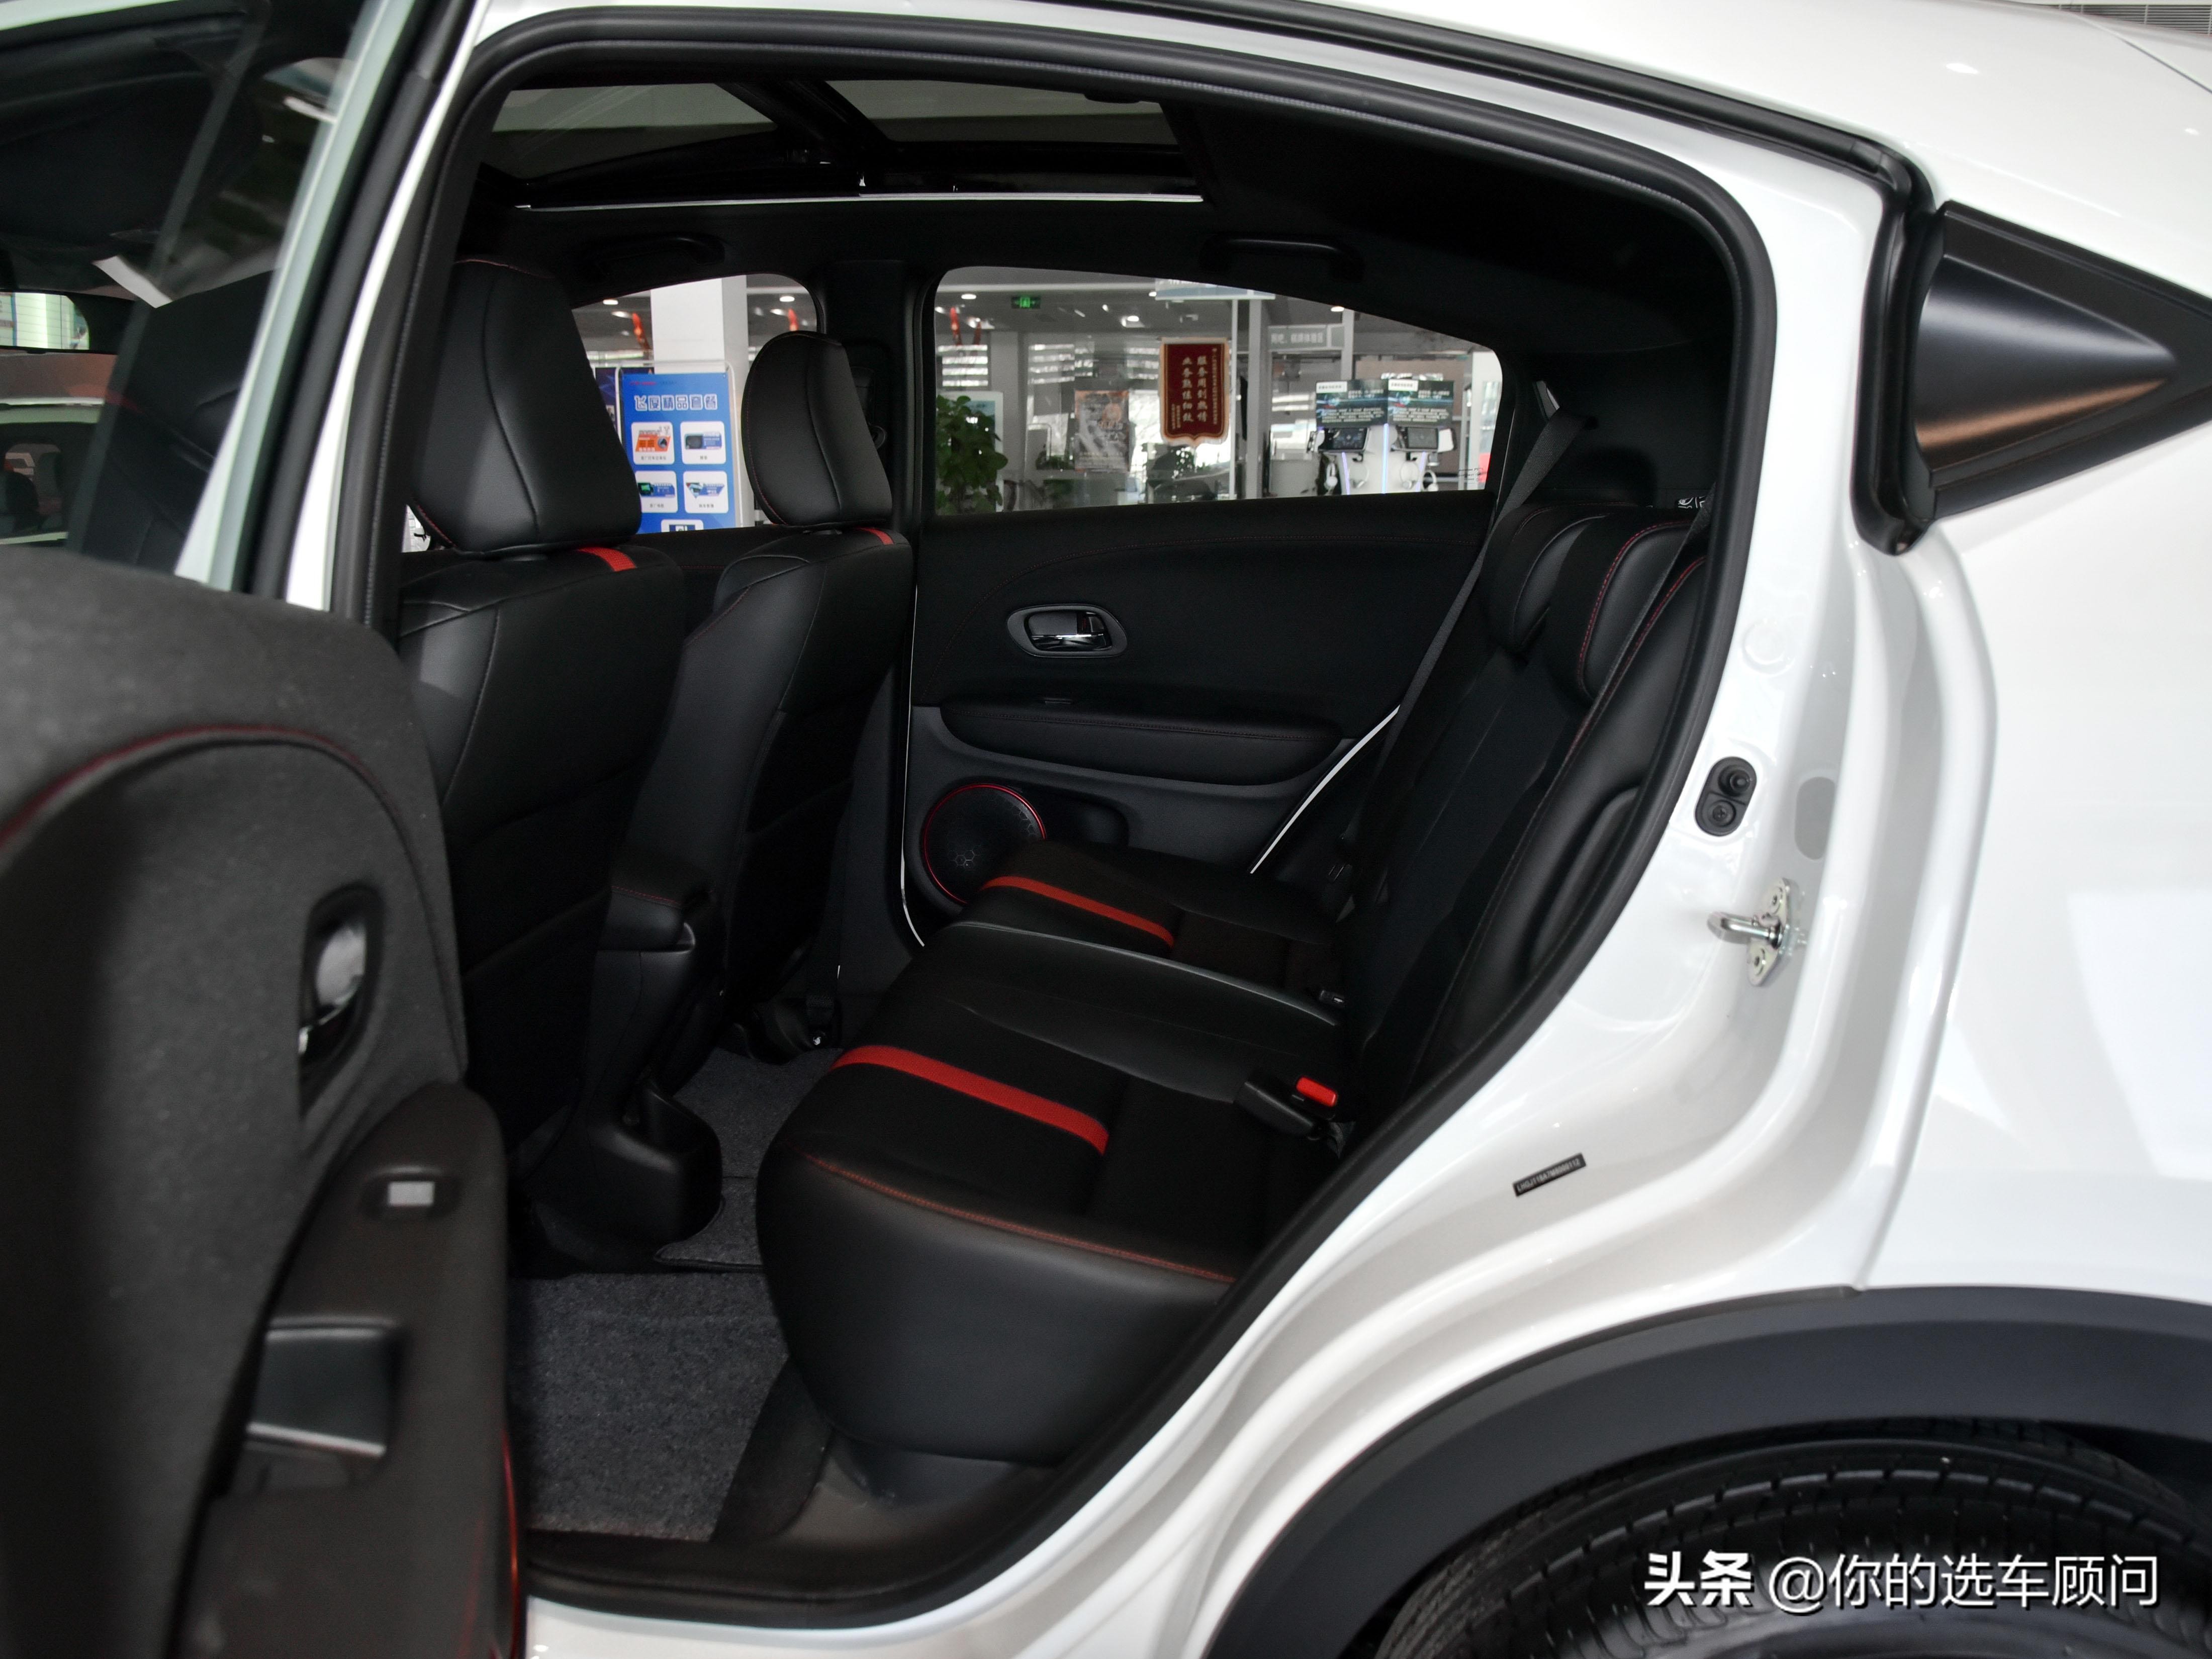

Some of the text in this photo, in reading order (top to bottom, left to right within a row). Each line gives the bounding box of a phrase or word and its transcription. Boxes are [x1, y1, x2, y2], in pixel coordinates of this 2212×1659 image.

[634, 394, 718, 411] 飞度精品套餐
